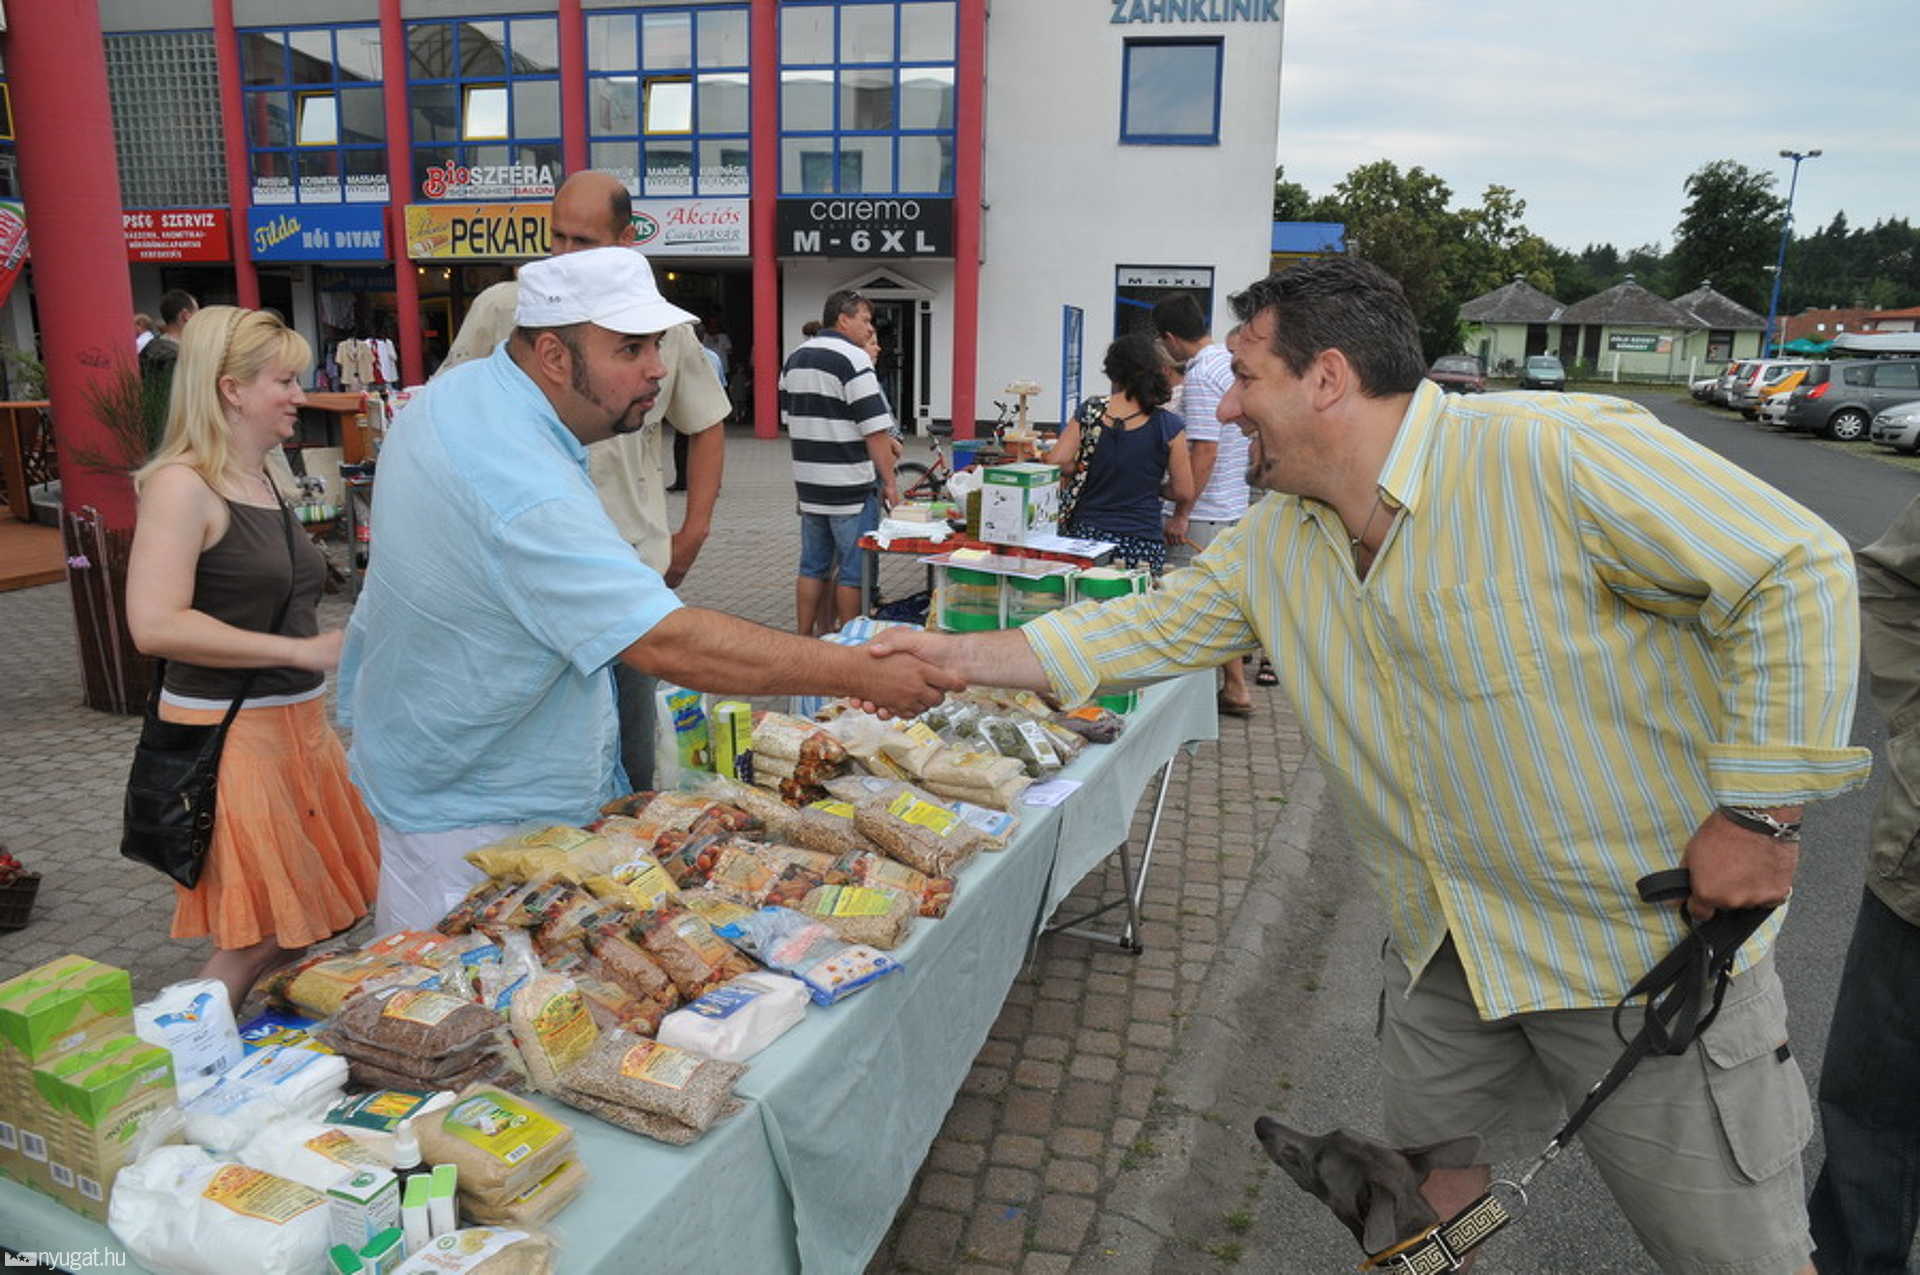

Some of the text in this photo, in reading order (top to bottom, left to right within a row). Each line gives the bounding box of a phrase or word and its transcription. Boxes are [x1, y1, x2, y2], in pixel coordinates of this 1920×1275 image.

[1110, 0, 1279, 24] ZAHNKLINIK
[161, 213, 216, 228] SZERVIZ
[666, 202, 741, 225] Akciós
[810, 200, 920, 221] caremo
